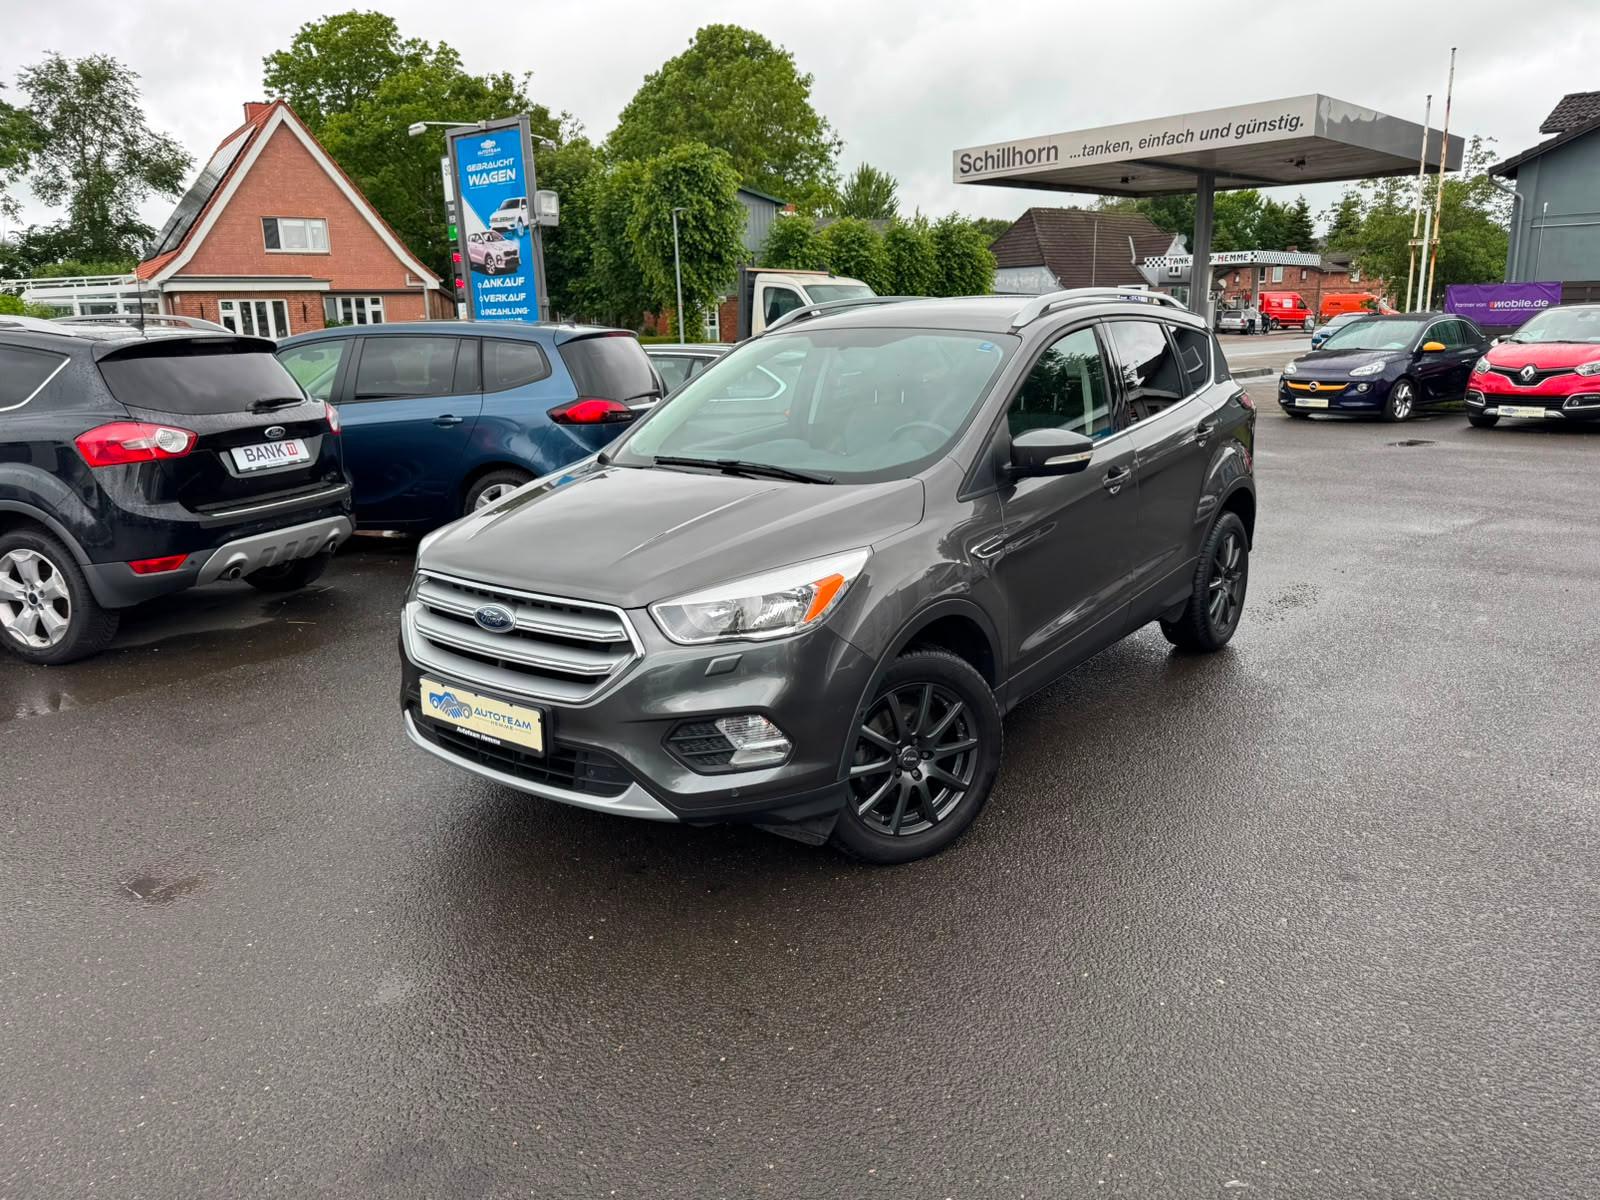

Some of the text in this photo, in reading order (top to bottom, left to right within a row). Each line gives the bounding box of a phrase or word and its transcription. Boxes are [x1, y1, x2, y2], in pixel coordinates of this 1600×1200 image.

[1138, 128, 1194, 149] einfach
[1199, 122, 1232, 141] und
[1234, 113, 1304, 139] günstig.
[466, 157, 514, 172] GEBRAUCHT
[959, 144, 1059, 174] Schillhorn
[468, 167, 516, 187] WAGEN
[1217, 252, 1249, 263] HEMME
[482, 276, 525, 288] ANKAUF
[483, 292, 526, 303] VERKAUF
[243, 443, 286, 462] BANK
[474, 707, 532, 731] AUTOTEAM
[490, 720, 513, 730] HEMME
[456, 726, 480, 739] Autoteam
